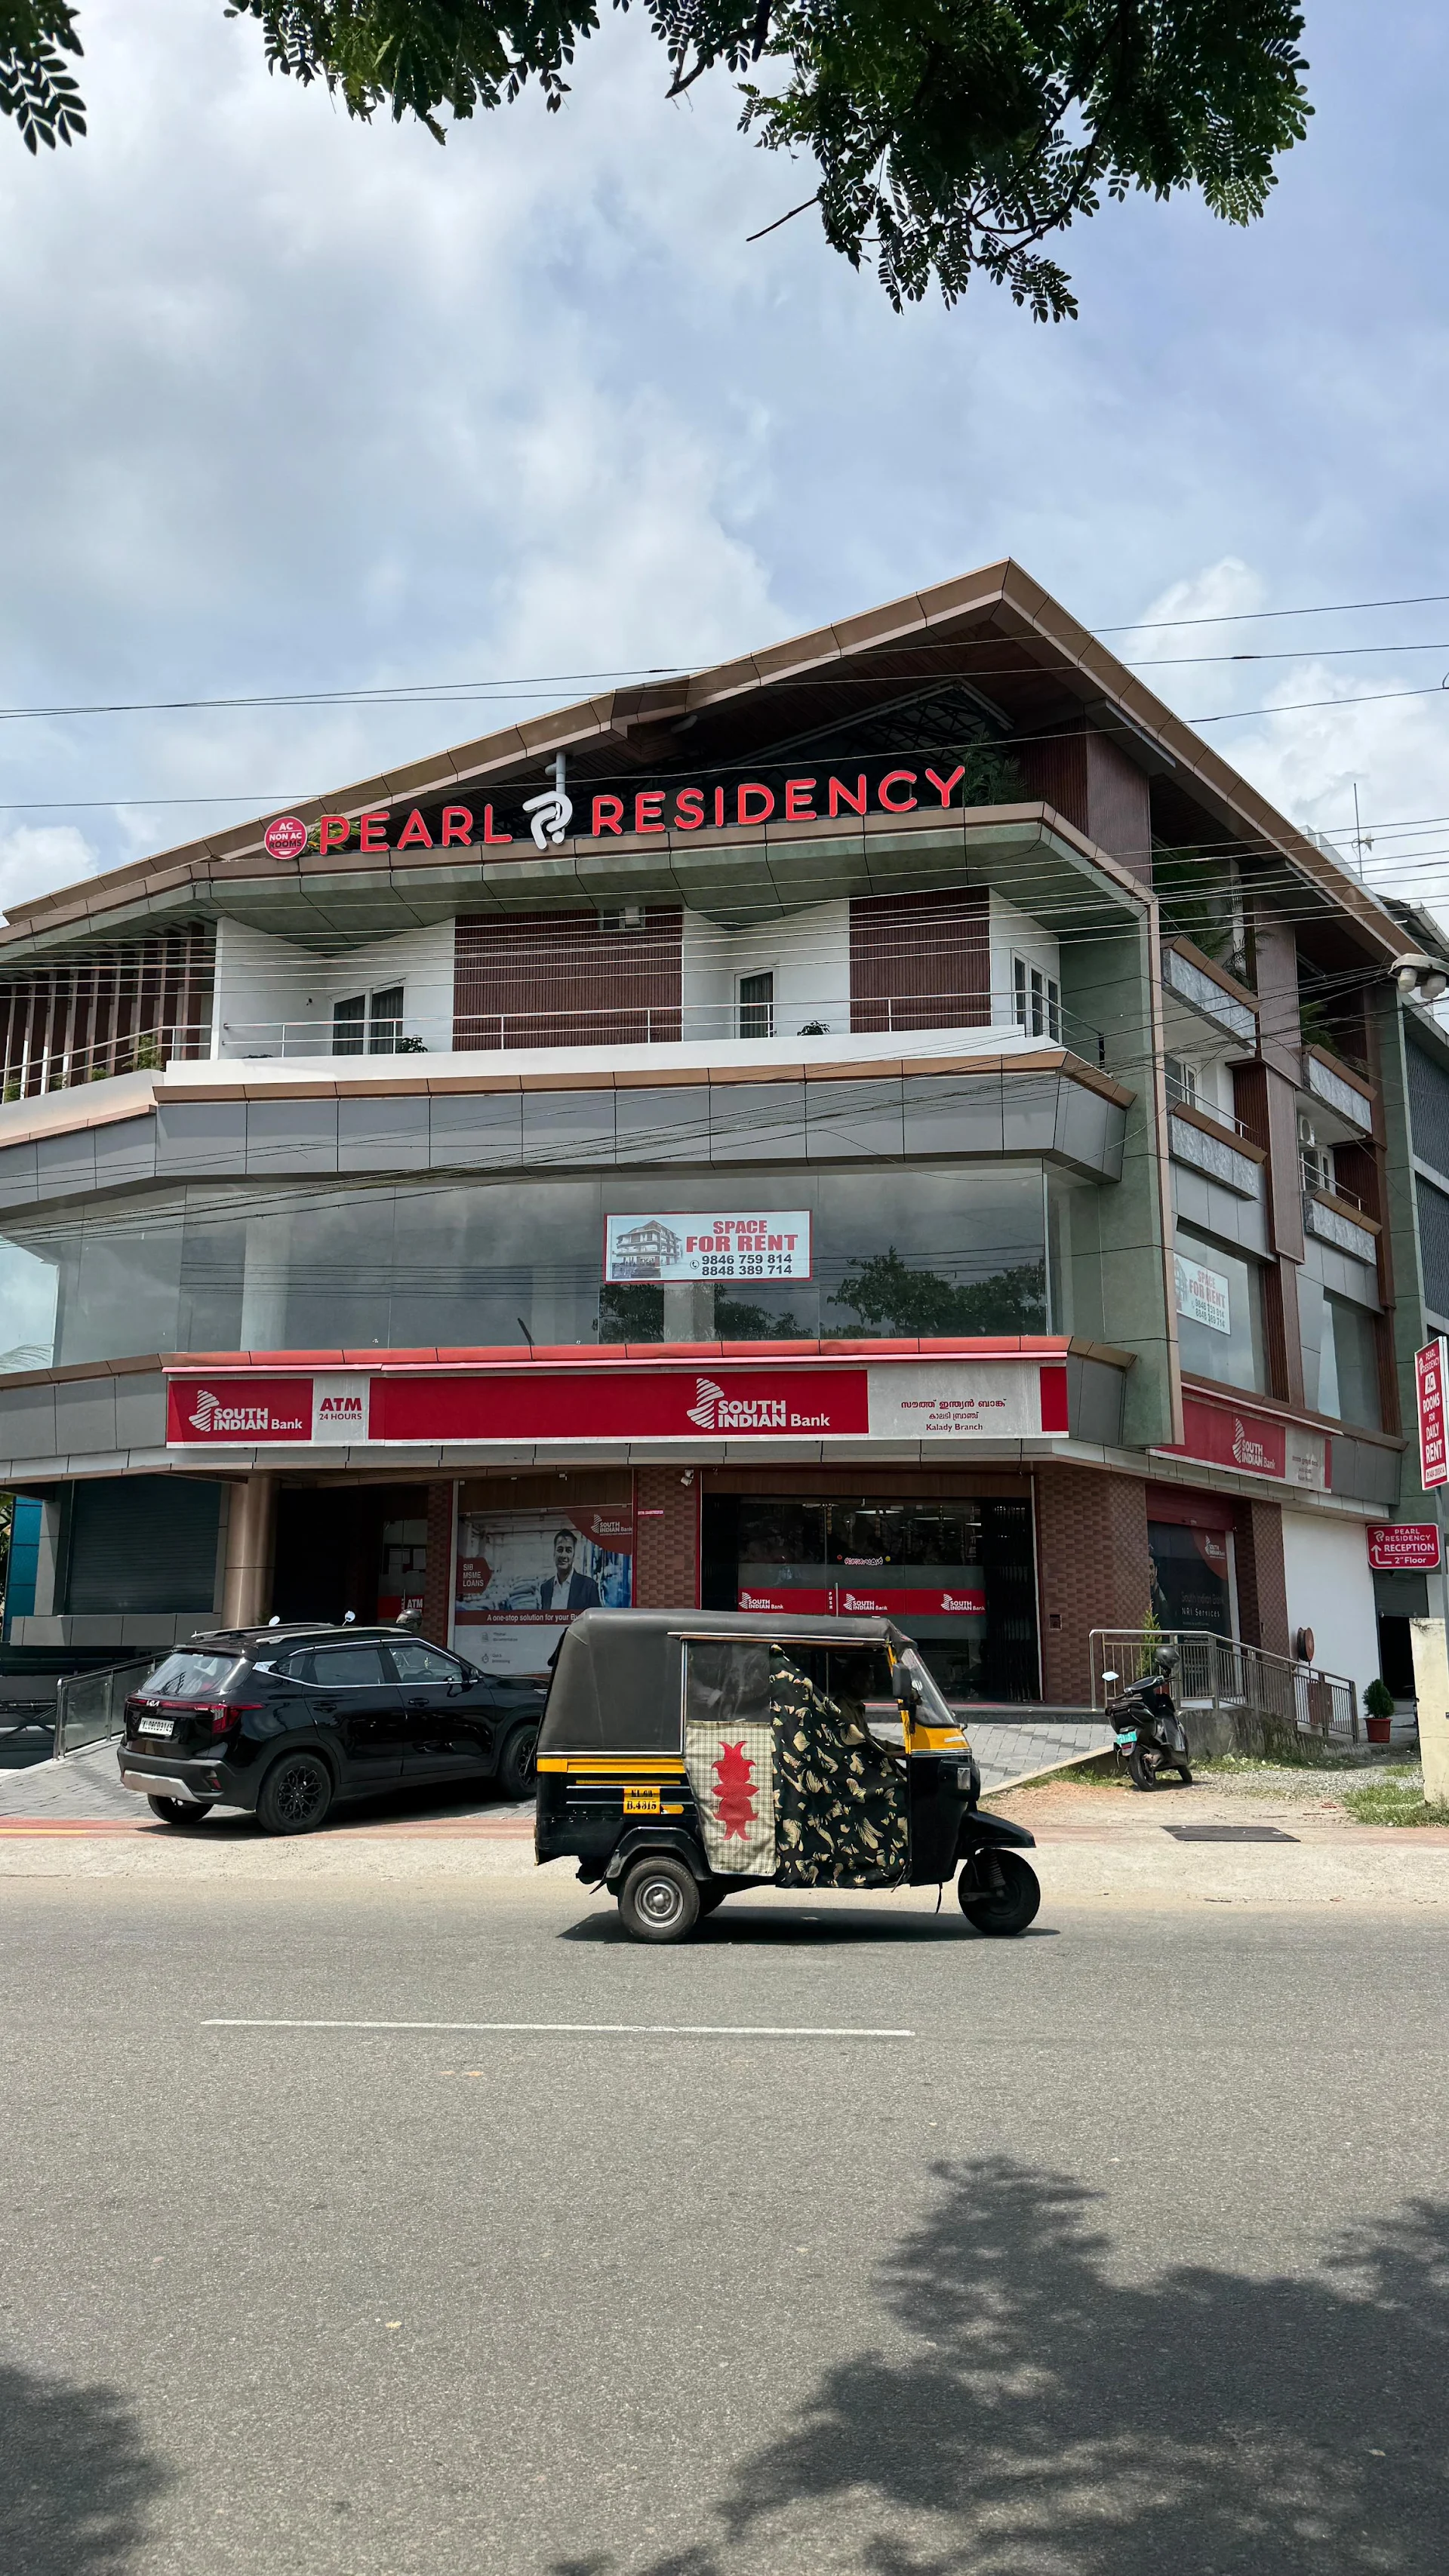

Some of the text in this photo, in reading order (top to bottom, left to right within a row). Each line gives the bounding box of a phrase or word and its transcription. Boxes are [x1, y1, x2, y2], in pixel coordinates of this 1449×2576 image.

[320, 765, 965, 856] PEARL RESIDENCY
[279, 822, 294, 831] AC
[269, 833, 288, 842] NON
[269, 839, 302, 848] ROOMS
[713, 1220, 768, 1235] SPACE
[686, 1234, 798, 1253] FOR RENT
[702, 1254, 792, 1265] 9846 759 814
[702, 1265, 792, 1276] 8848 389 714
[1198, 1270, 1216, 1289] SPACE
[1189, 1279, 1226, 1309] FOR RENT
[1427, 1375, 1434, 1390] AC
[320, 1398, 362, 1411] ATM
[718, 1400, 786, 1414] SOUTH
[1423, 1392, 1440, 1414] ROOMS
[214, 1408, 268, 1419] SOUTH
[214, 1419, 302, 1430] INDIAN Bank
[718, 1414, 830, 1427] INDIAN Bank
[926, 1423, 952, 1433] Kalady
[1426, 1422, 1440, 1441] DAILY
[1242, 1439, 1263, 1456] SOUTH
[1425, 1439, 1442, 1464] RENT
[1241, 1451, 1263, 1467] INDIAN
[1263, 1457, 1276, 1470] Bank
[1384, 1543, 1434, 1552] RECEPTION
[408, 1599, 423, 1608] ATM
[493, 1614, 518, 1622] one-stop
[555, 1614, 569, 1623] your
[1182, 1607, 1220, 1617] NRI Services
